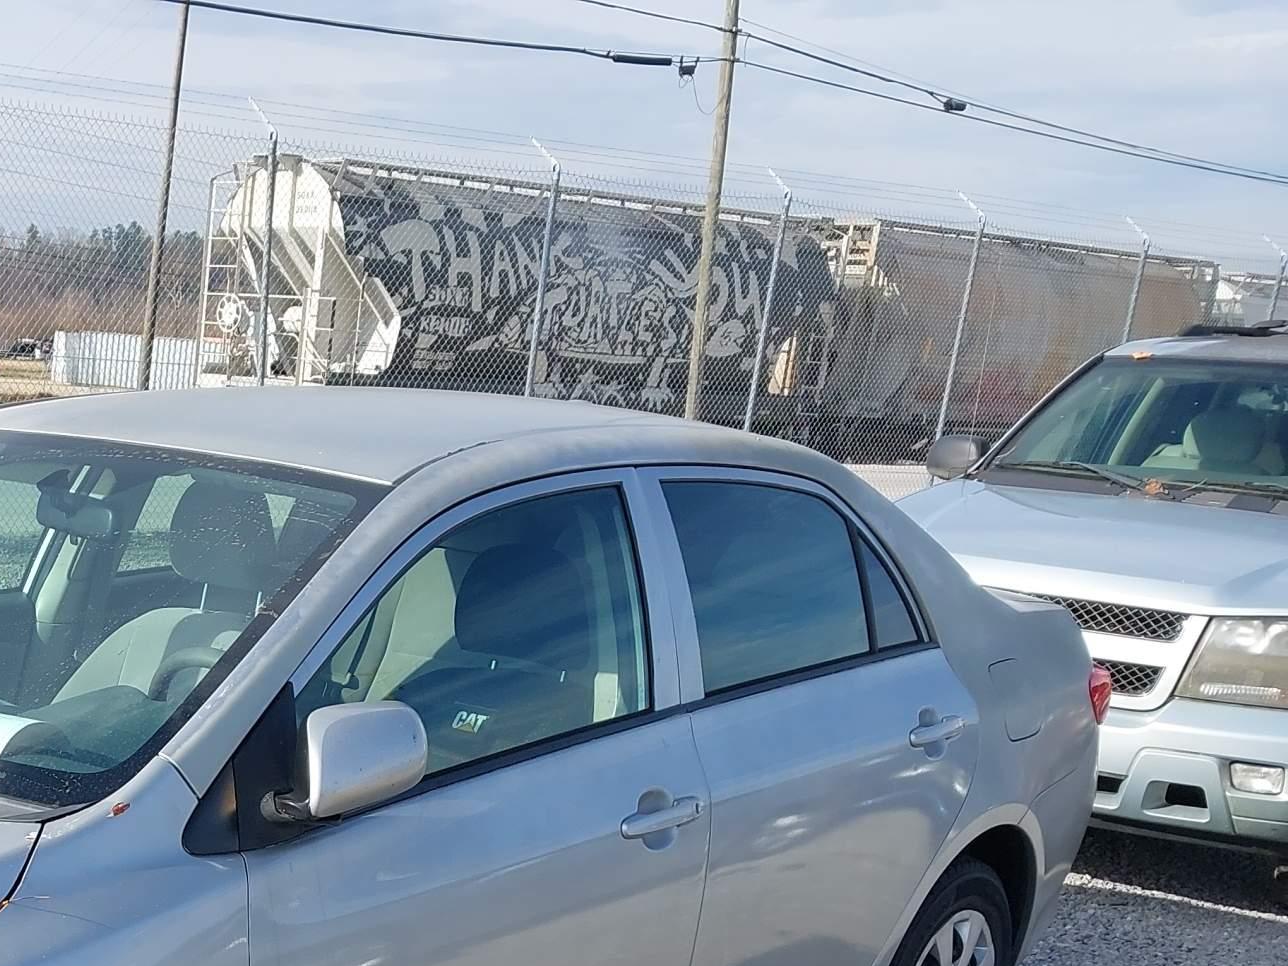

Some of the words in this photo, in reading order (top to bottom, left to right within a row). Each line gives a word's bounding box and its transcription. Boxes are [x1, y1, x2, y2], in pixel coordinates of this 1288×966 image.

[379, 218, 584, 313] THANK
[648, 248, 763, 332] YOU
[452, 710, 490, 734] CAT
